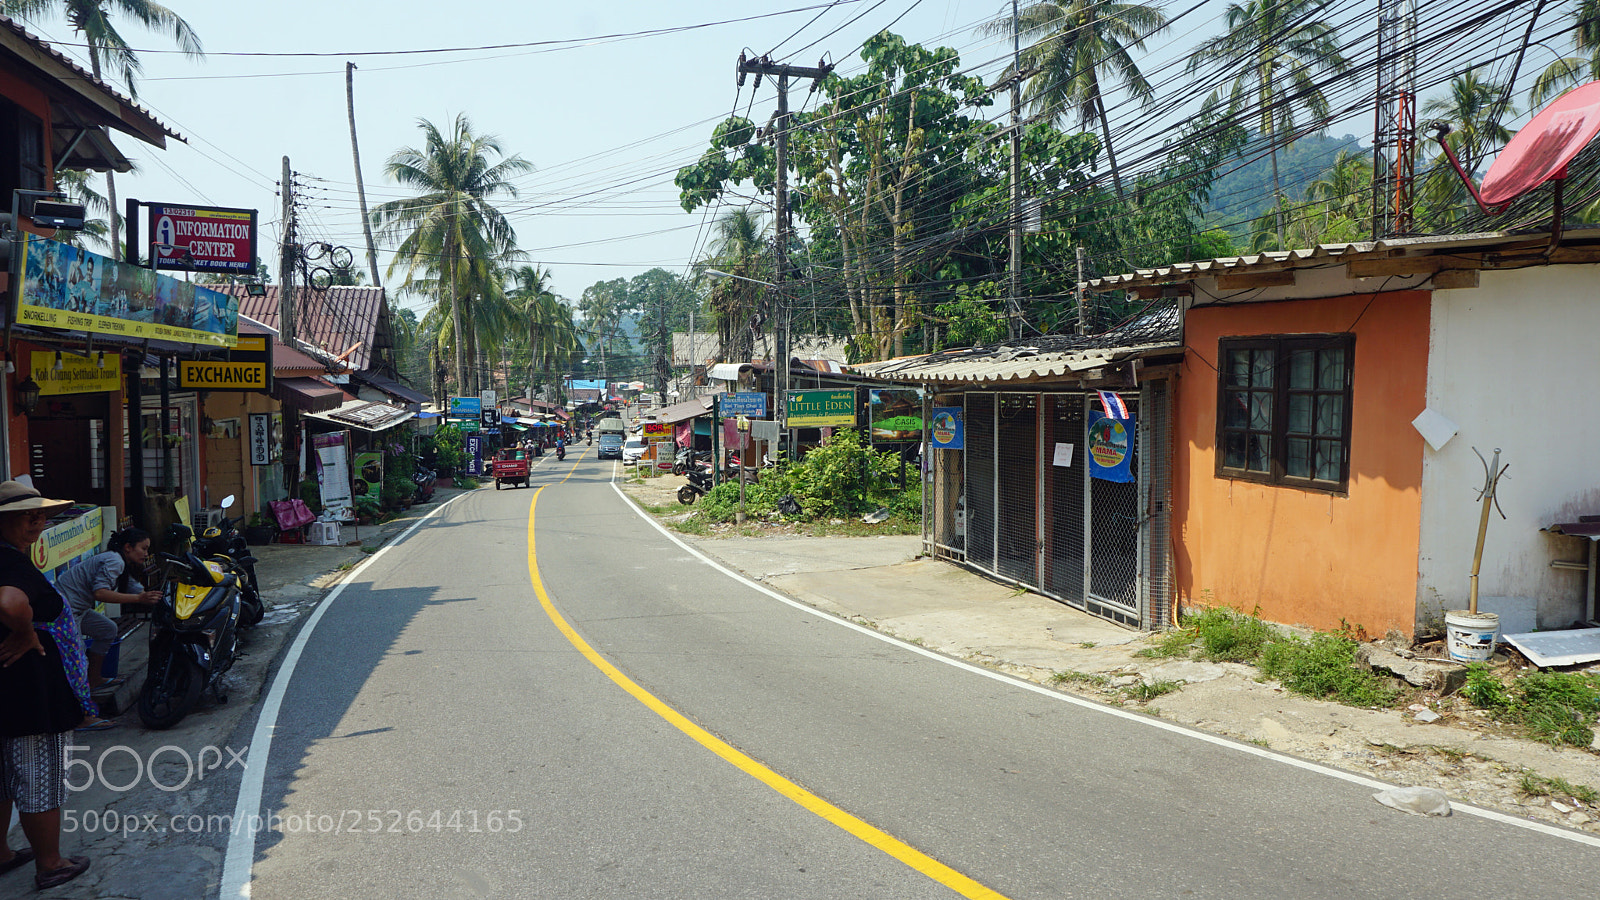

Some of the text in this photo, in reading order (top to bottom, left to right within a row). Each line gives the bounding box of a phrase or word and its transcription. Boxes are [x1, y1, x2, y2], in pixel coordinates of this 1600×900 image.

[176, 220, 250, 240] INFORMATION
[189, 241, 236, 258] CENTER
[228, 262, 249, 270] HERE!
[23, 310, 57, 324] SNORKELLING
[36, 368, 50, 382] Koh
[50, 368, 72, 383] Chang
[187, 366, 261, 383] EXCHANGE
[790, 400, 852, 412] LITTLE EDEN
[1096, 446, 1117, 456] MAMA
[47, 520, 84, 548] Information
